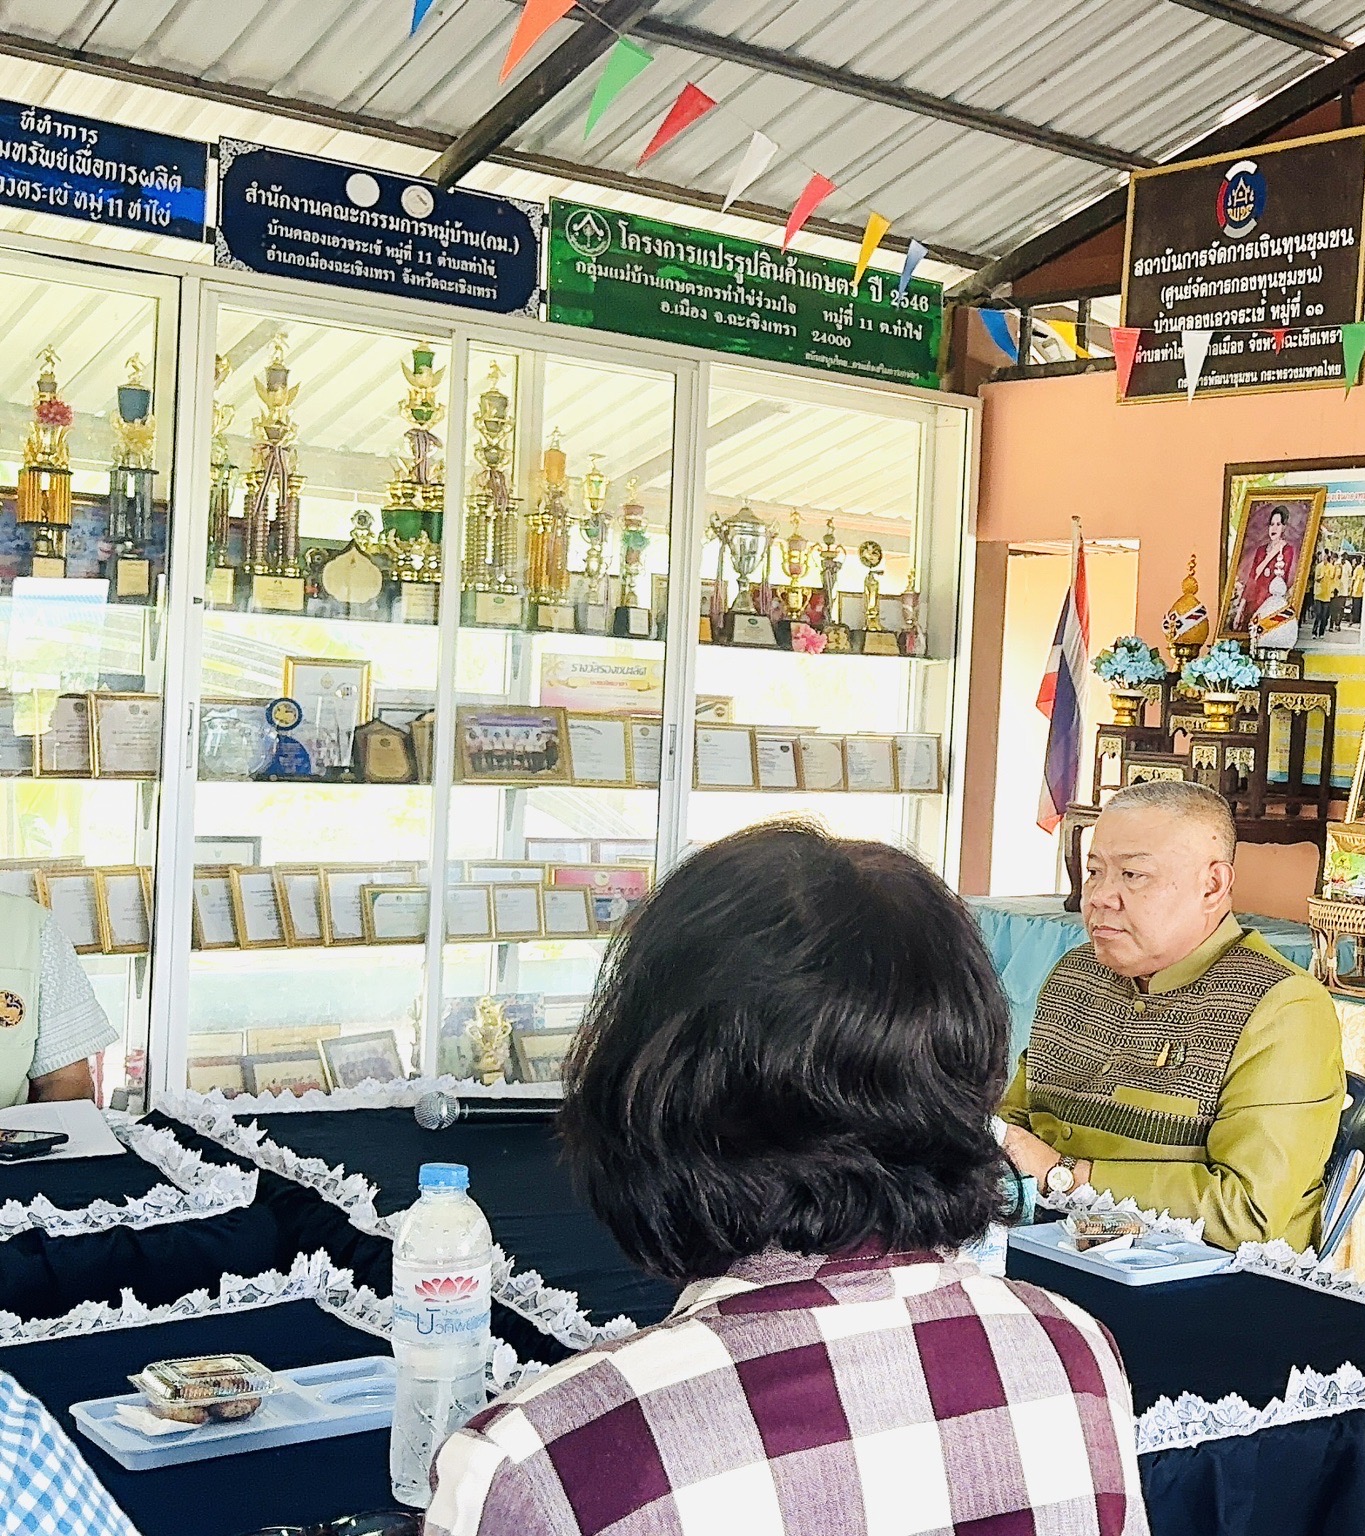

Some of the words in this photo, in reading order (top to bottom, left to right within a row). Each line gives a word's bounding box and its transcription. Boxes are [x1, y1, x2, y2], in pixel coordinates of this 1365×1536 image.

[20, 106, 99, 145] ที่ทำการ
[73, 188, 104, 220] หมู่
[108, 198, 123, 219] 11
[267, 219, 383, 256] บ้านคลองเอวจระเข้
[384, 239, 414, 266] หมู่ที่
[417, 250, 433, 265] 11
[618, 219, 859, 298] โครงการแปรรูปสินค้าเกษตร
[868, 275, 883, 303] ปี
[1133, 226, 1355, 278] สถาบันการจัดการเงินทุนชุมชน
[266, 243, 396, 282] อำเภอเมืองฉะเชิงเทรา
[402, 267, 498, 300] จังหวัดฉะเชิงเทรา
[1160, 265, 1323, 309] (ศูนย์จัดการกองทุนชุมชน)
[660, 298, 708, 320] อ.เมือง
[811, 330, 852, 348] 24000
[822, 303, 854, 331] หมู่ที่
[859, 317, 874, 332] 11
[1153, 299, 1267, 334] บ้านคลองเอวจระเข้
[1270, 290, 1302, 326] หมู่ที่
